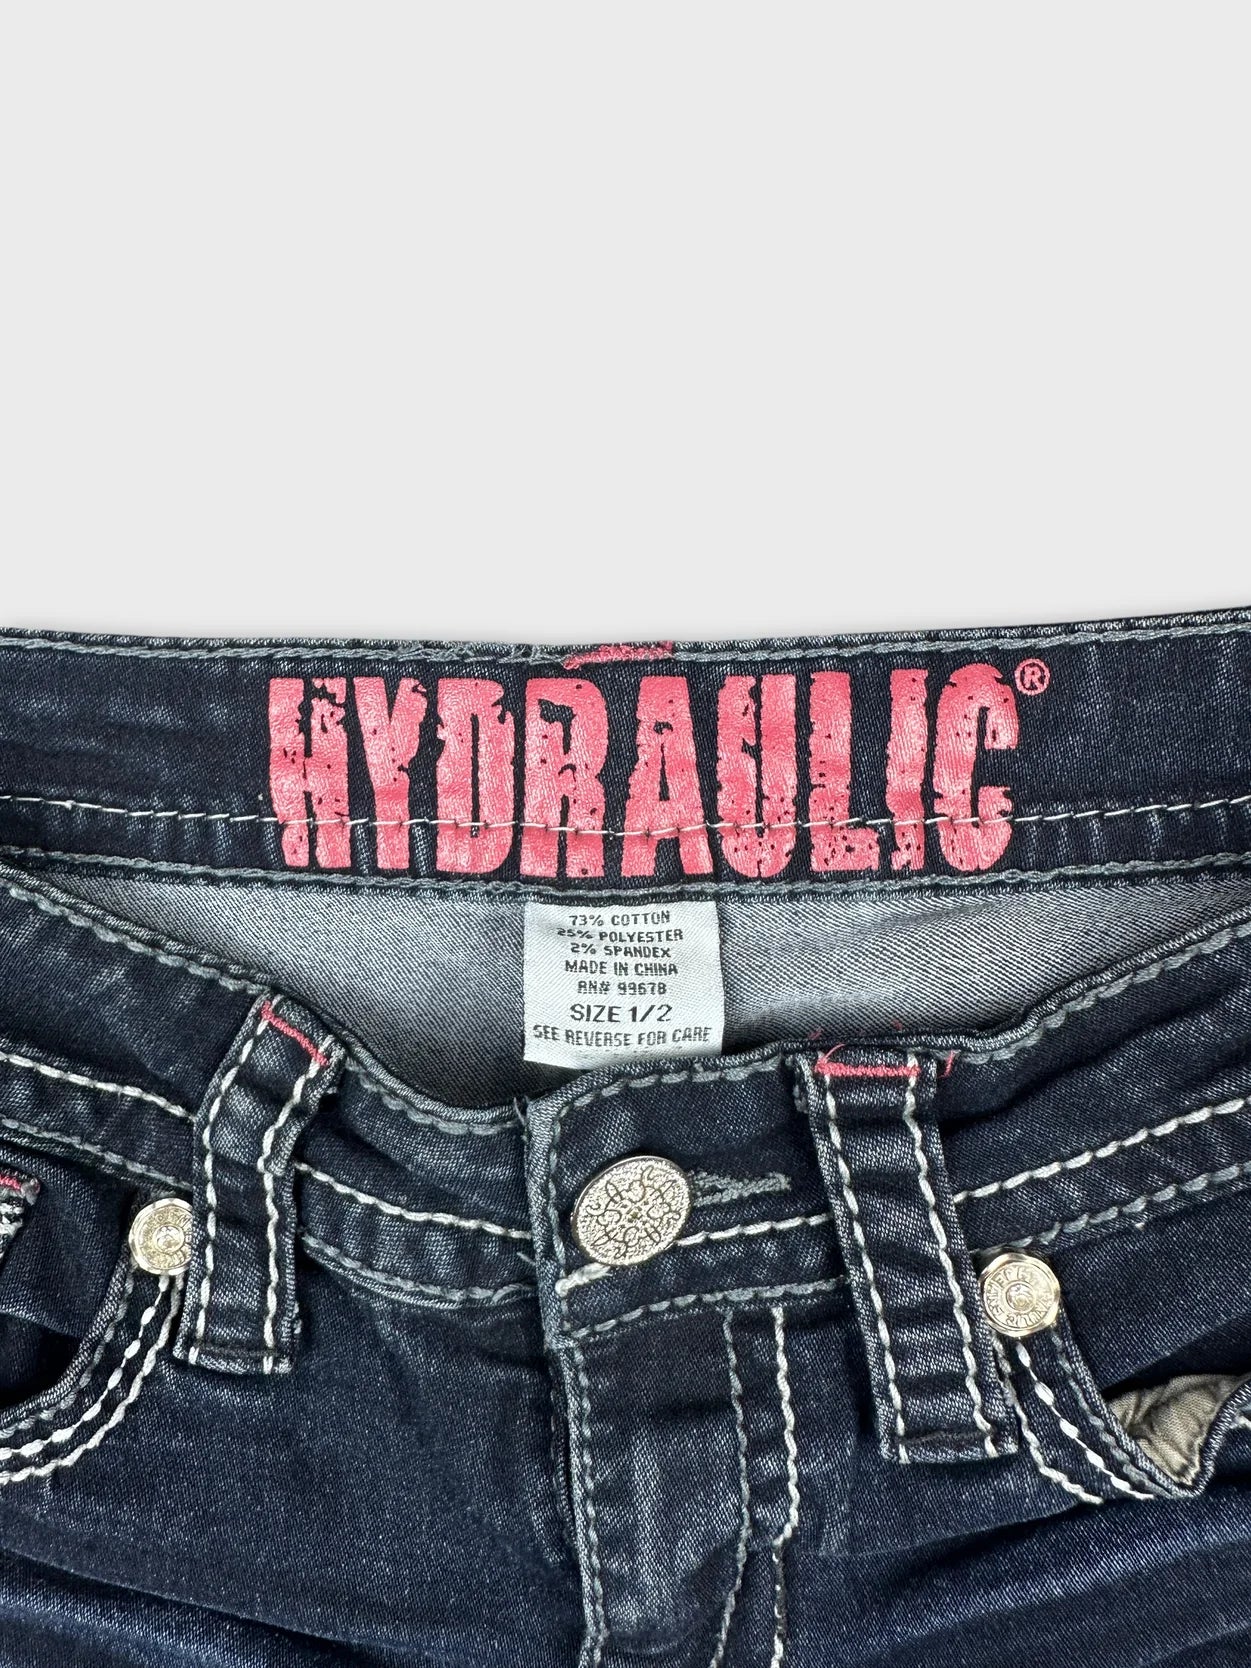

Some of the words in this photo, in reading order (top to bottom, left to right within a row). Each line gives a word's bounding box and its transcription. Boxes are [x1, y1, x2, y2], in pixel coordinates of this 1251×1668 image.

[268, 664, 1019, 879] HYDRAULIC
[569, 915, 604, 927] 73%
[611, 910, 670, 926] COTTON
[557, 927, 593, 939] 25%
[599, 929, 683, 943] POLYESTER
[570, 943, 596, 955] 2%
[604, 946, 671, 958] SPANDEX
[565, 960, 607, 974] MADE
[614, 962, 629, 976] IN
[634, 963, 678, 976] CHINA
[577, 980, 610, 994] RN#
[617, 981, 667, 995] 99678
[569, 1003, 622, 1023] SIZE
[628, 1004, 673, 1022] 1/2
[533, 1024, 560, 1041] SEE
[565, 1029, 633, 1047] REVERSE
[638, 1031, 667, 1046] FOR
[672, 1026, 712, 1042] CARE
